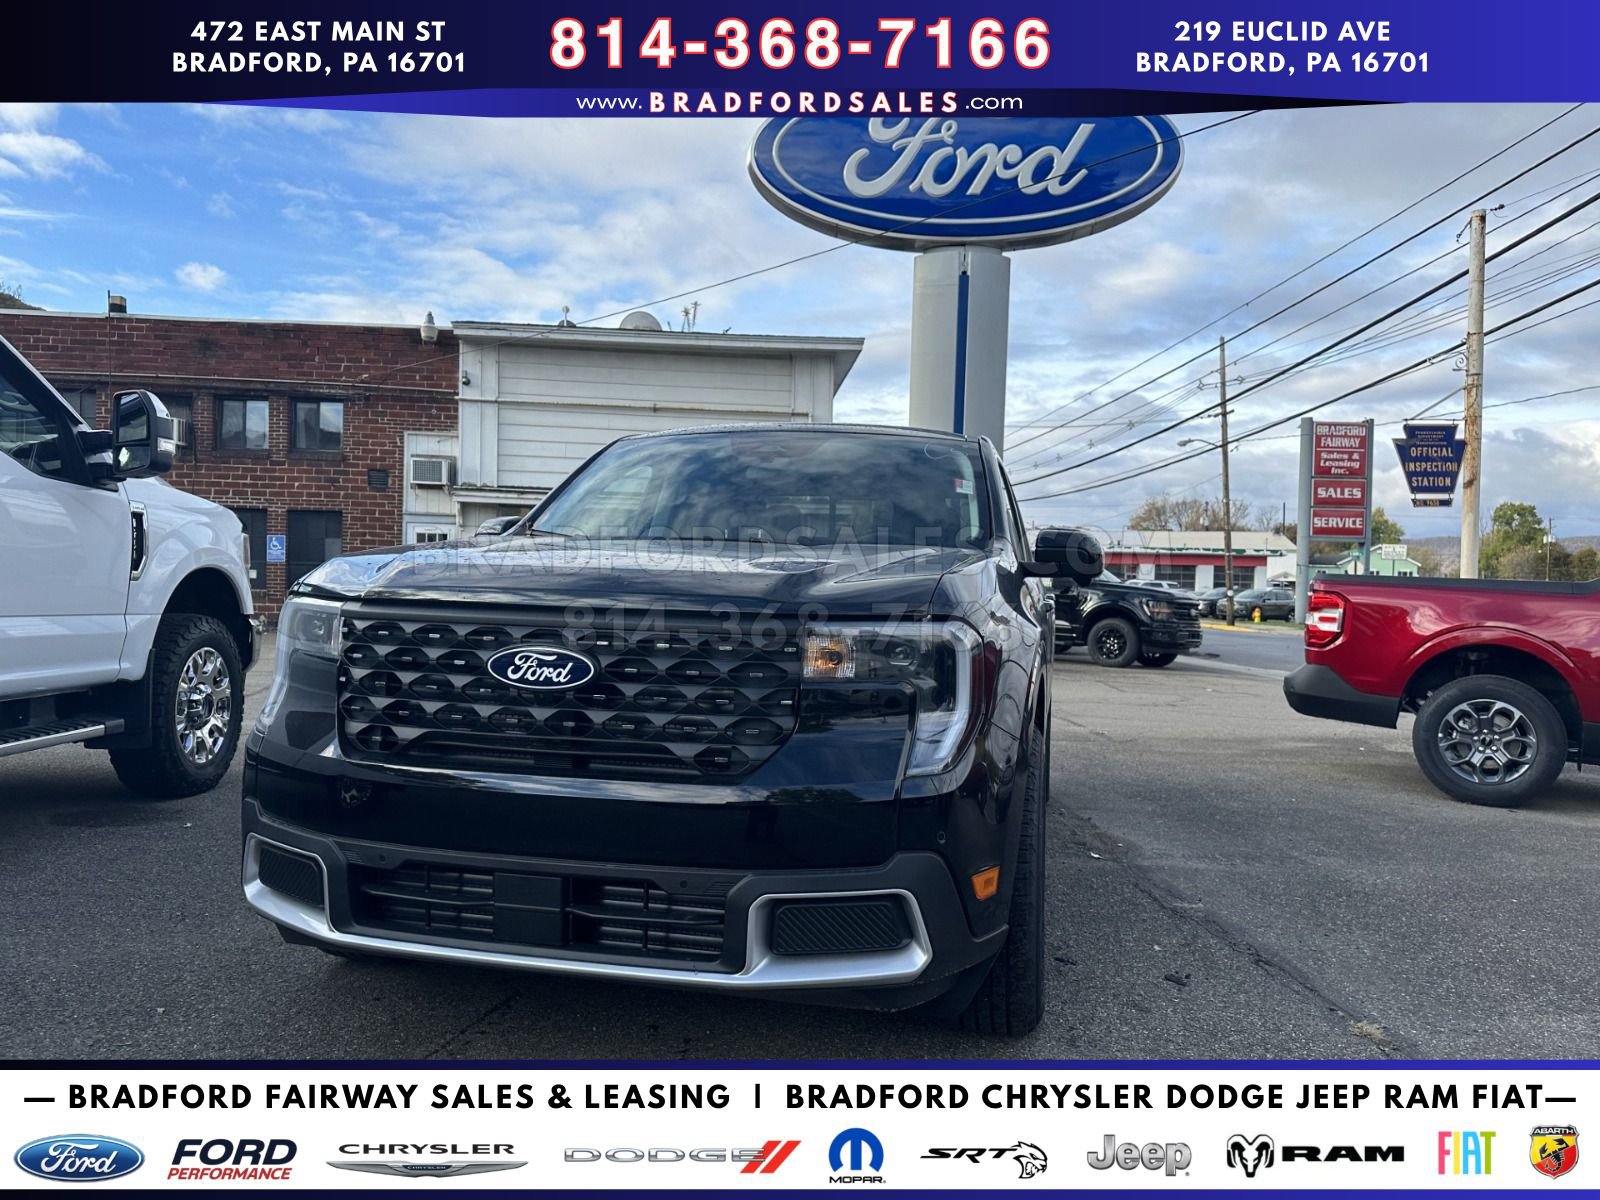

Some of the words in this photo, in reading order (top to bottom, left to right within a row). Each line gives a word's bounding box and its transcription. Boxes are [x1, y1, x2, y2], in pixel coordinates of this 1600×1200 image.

[843, 116, 1096, 198] Ford
[1316, 424, 1366, 436] BRADFORD
[1320, 437, 1361, 447] FAIRWAY
[1410, 447, 1454, 457] OFFICIAL
[1320, 460, 1360, 469] Leasing
[1405, 461, 1458, 472] INSPECTION
[1411, 476, 1451, 487] STATION
[1317, 487, 1362, 498] SALES
[1313, 517, 1363, 528] SERVICE
[507, 652, 574, 683] Ford
